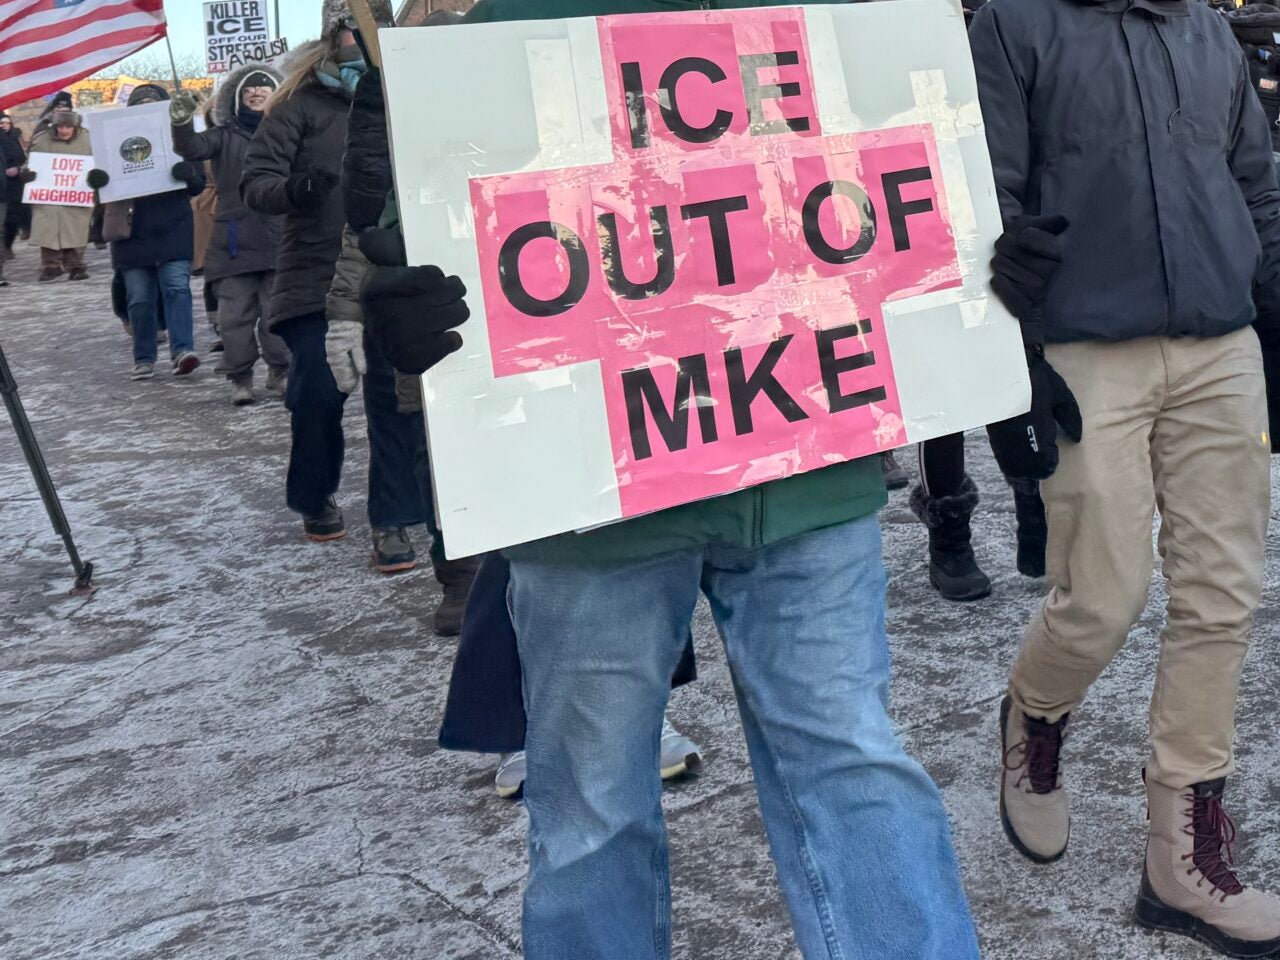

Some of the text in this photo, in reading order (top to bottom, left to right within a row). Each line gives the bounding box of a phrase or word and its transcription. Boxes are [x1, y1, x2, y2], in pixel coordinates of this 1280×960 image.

[210, 0, 259, 19] KILLER
[206, 17, 265, 36] ICE
[208, 34, 267, 45] OFF OUR
[208, 41, 267, 61] STRE
[228, 37, 288, 71] ABOLISH
[620, 50, 810, 150] ICE
[52, 158, 83, 171] LOVE
[53, 174, 78, 187] THY
[29, 188, 94, 203] NEIGHBOR
[498, 166, 935, 317] OUT OF
[620, 318, 887, 461] MKE
